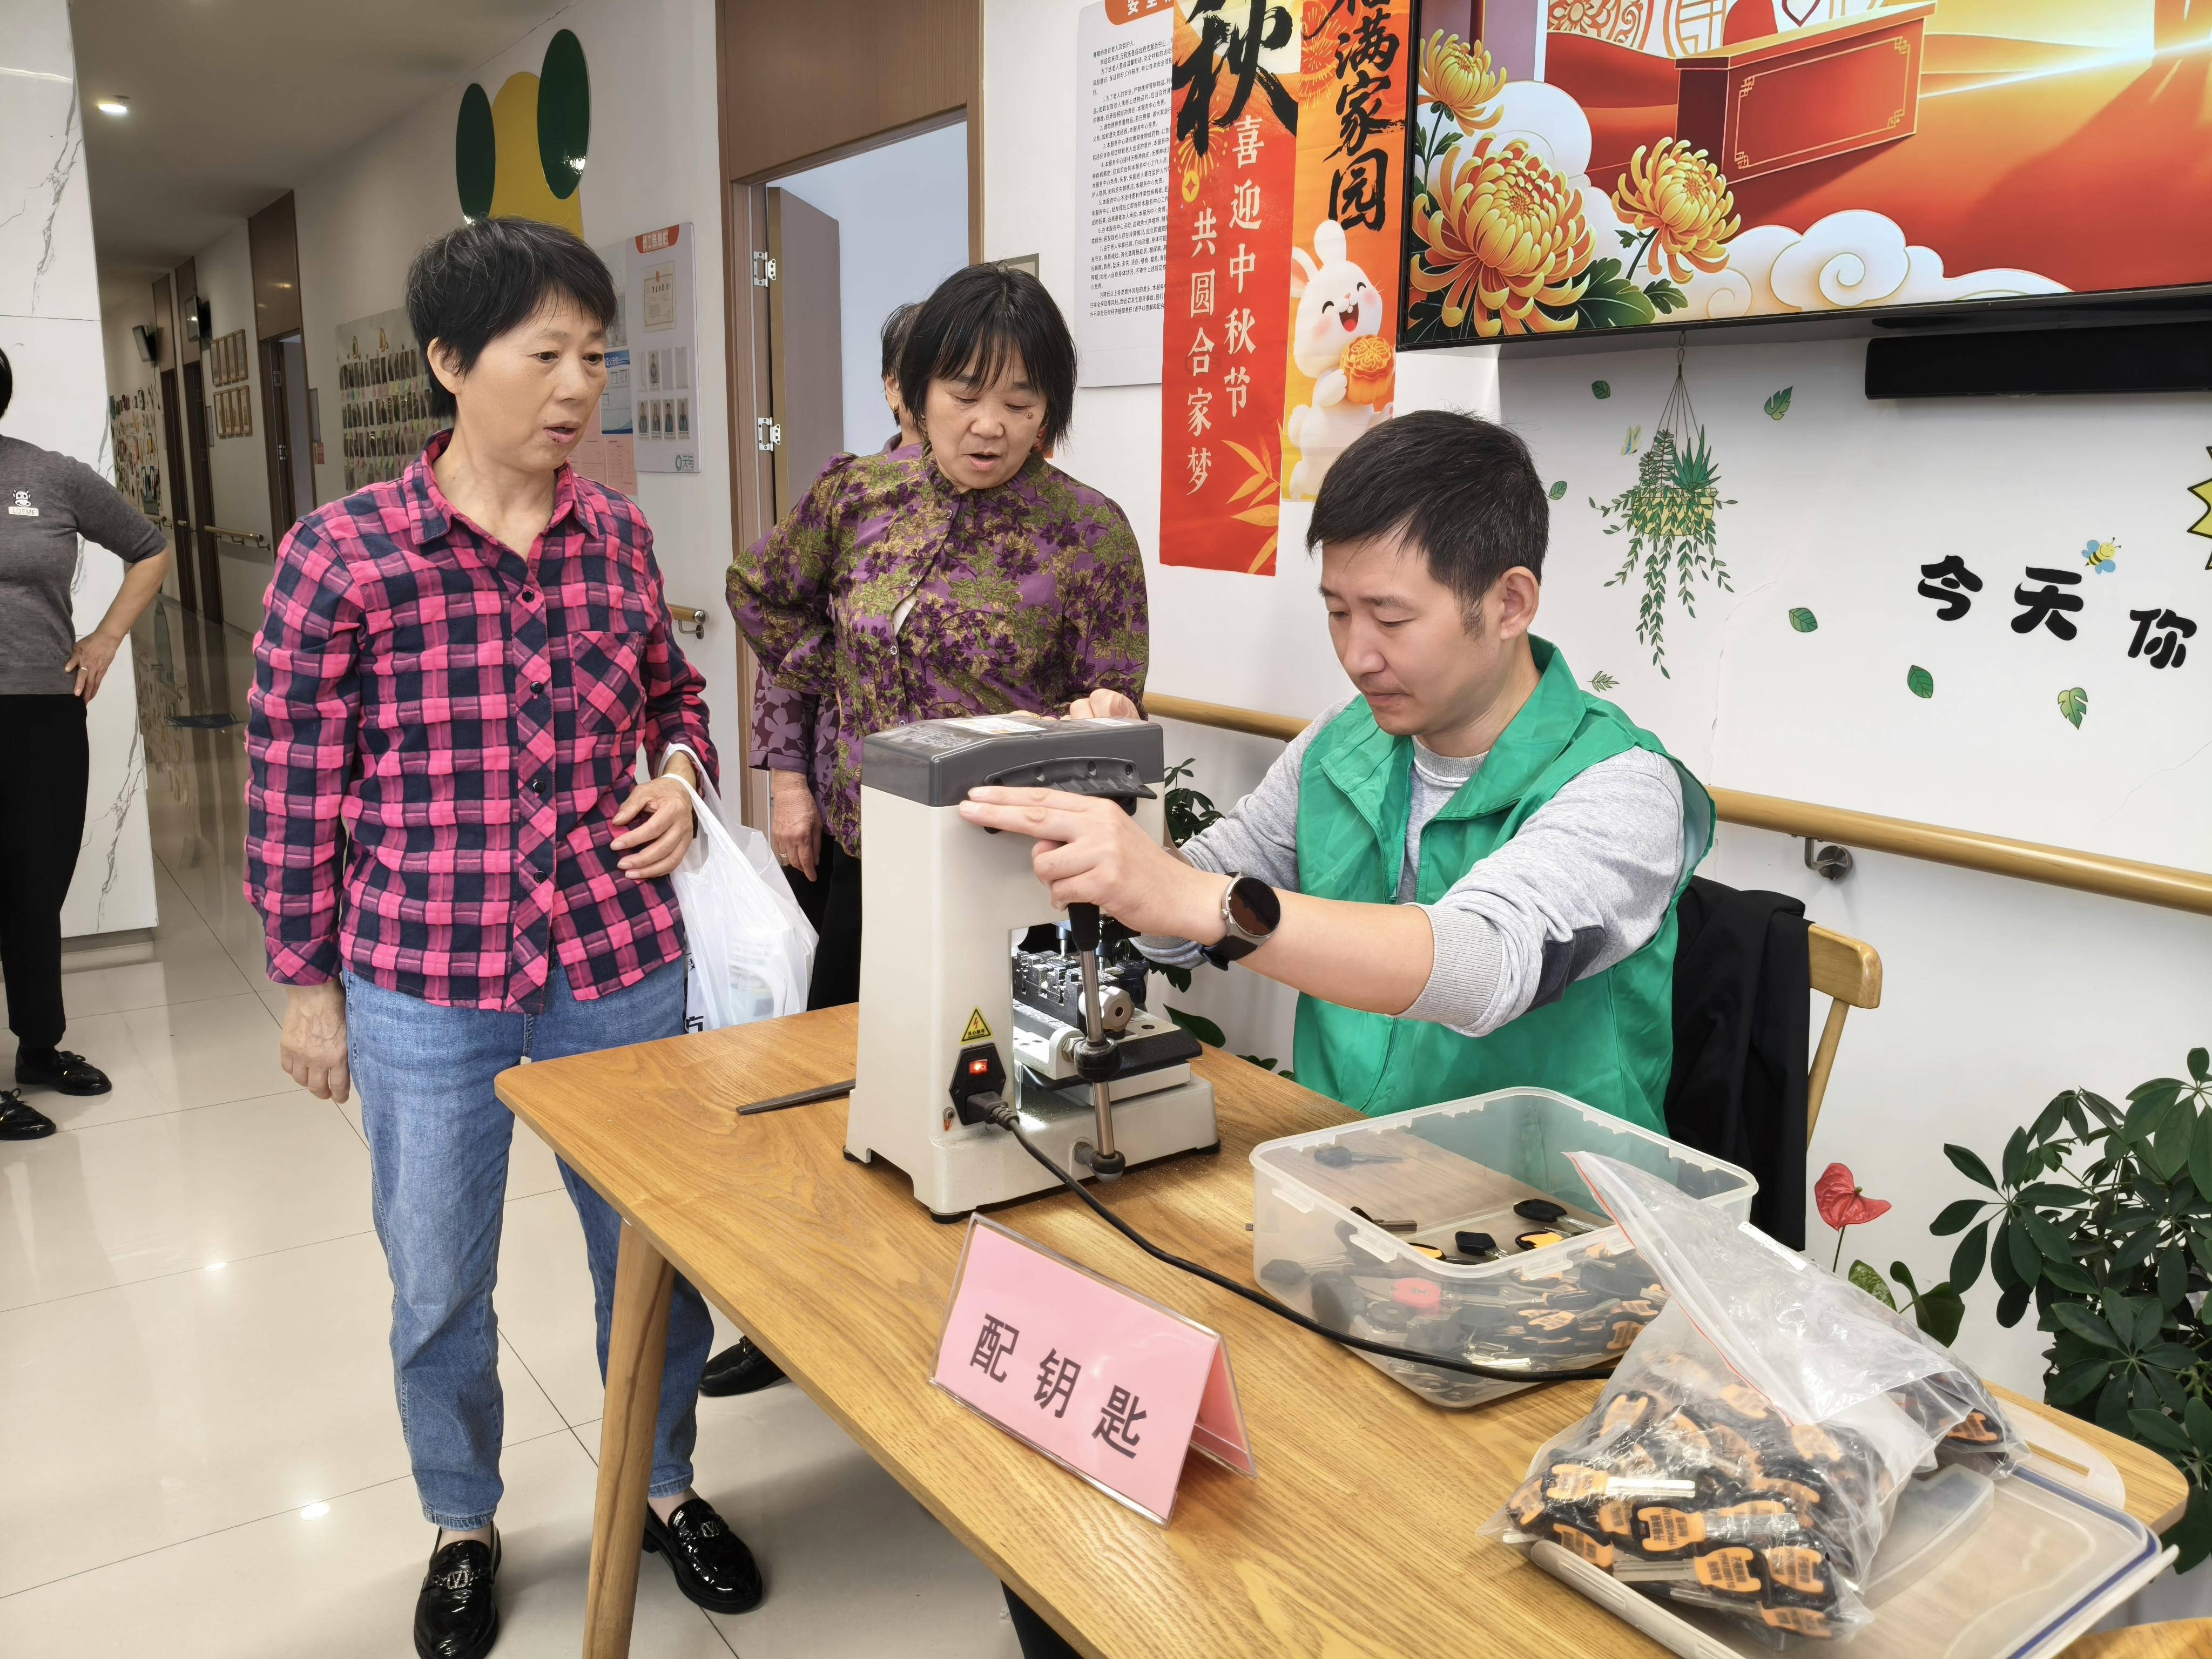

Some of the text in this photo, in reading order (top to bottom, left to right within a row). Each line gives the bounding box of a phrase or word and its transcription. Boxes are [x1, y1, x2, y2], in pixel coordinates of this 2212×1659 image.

[1303, 0, 1404, 232] 满家园
[1186, 207, 1216, 496] 共圆合家梦
[1224, 114, 1265, 417] 喜迎中秋节
[1917, 555, 2197, 669] 今天你
[969, 1313, 1147, 1459] 配钥匙
